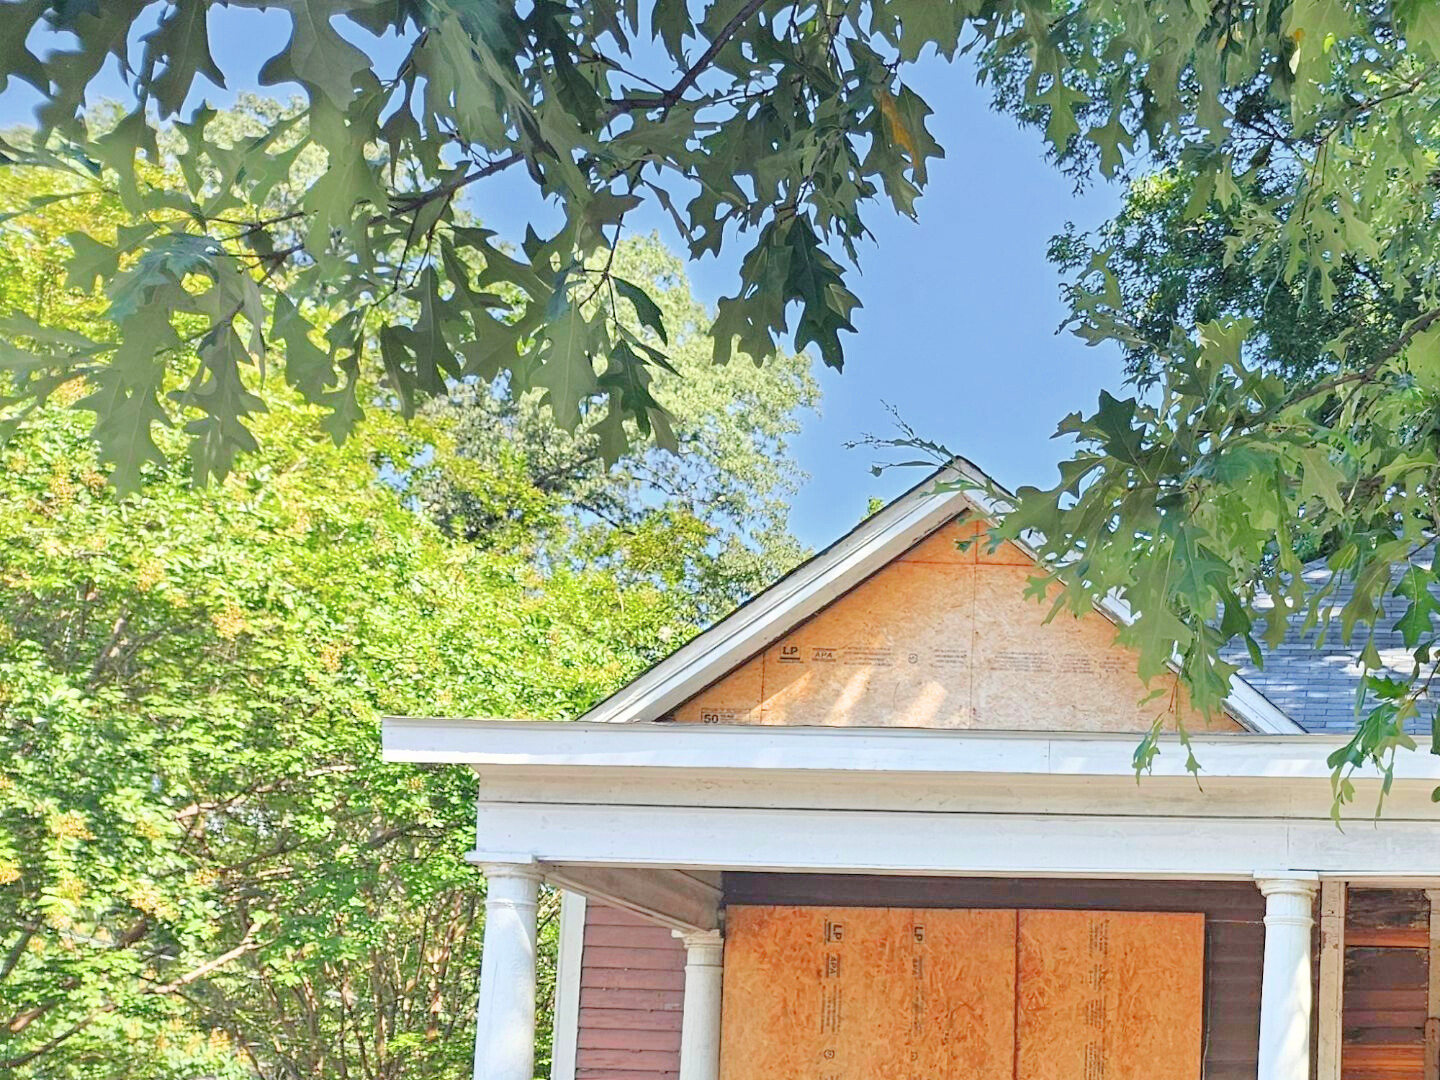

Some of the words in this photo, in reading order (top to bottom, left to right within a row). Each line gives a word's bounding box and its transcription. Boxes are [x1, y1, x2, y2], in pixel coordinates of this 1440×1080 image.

[782, 646, 798, 655] LP
[703, 714, 719, 724] 50
[833, 924, 843, 940] LP
[914, 926, 924, 941] LP
